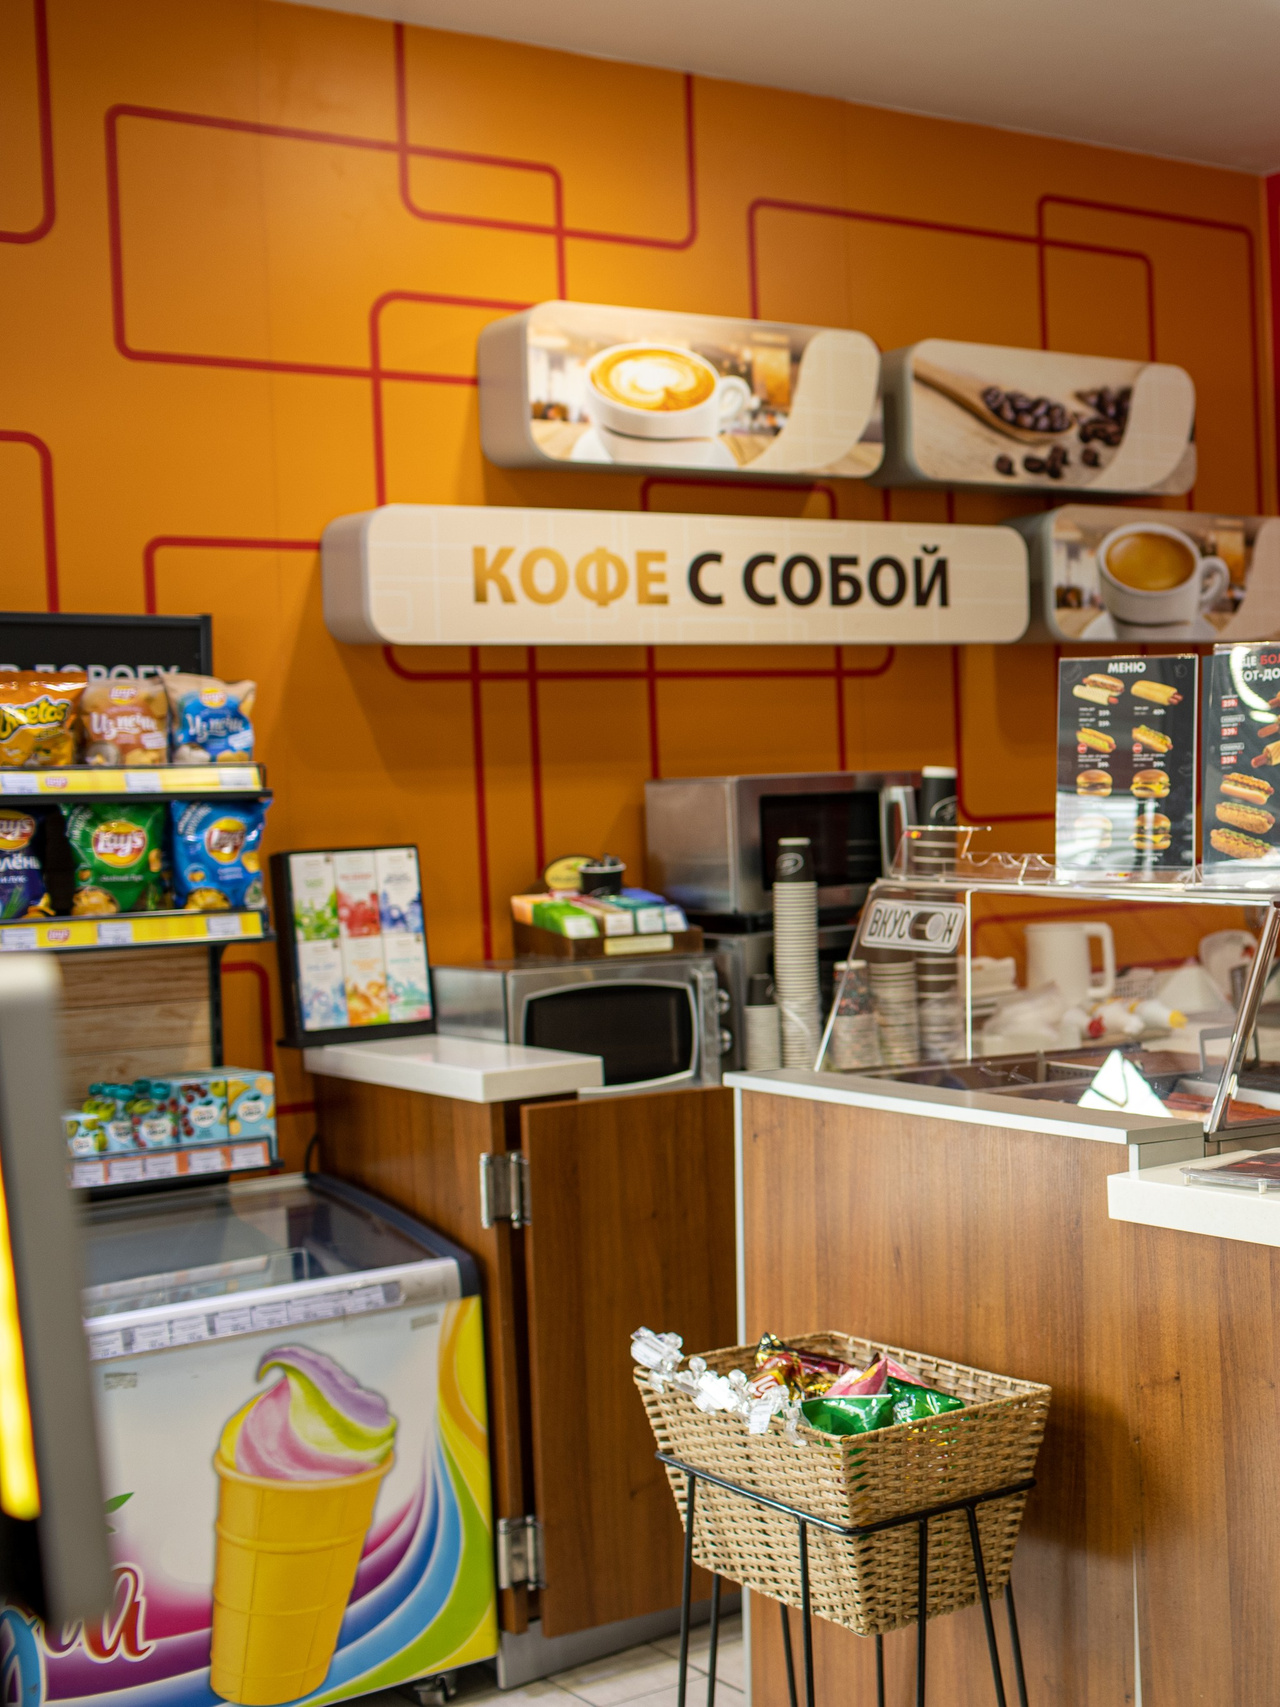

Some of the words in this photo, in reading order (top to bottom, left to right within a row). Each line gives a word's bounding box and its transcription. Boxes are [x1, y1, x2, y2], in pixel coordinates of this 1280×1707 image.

[471, 545, 670, 608] КОФЕ
[686, 552, 725, 605] С
[742, 545, 950, 608] СОБОЙ
[1107, 662, 1147, 674] МЕНЮ
[0, 819, 31, 838] ay's
[97, 830, 145, 857] Lay's
